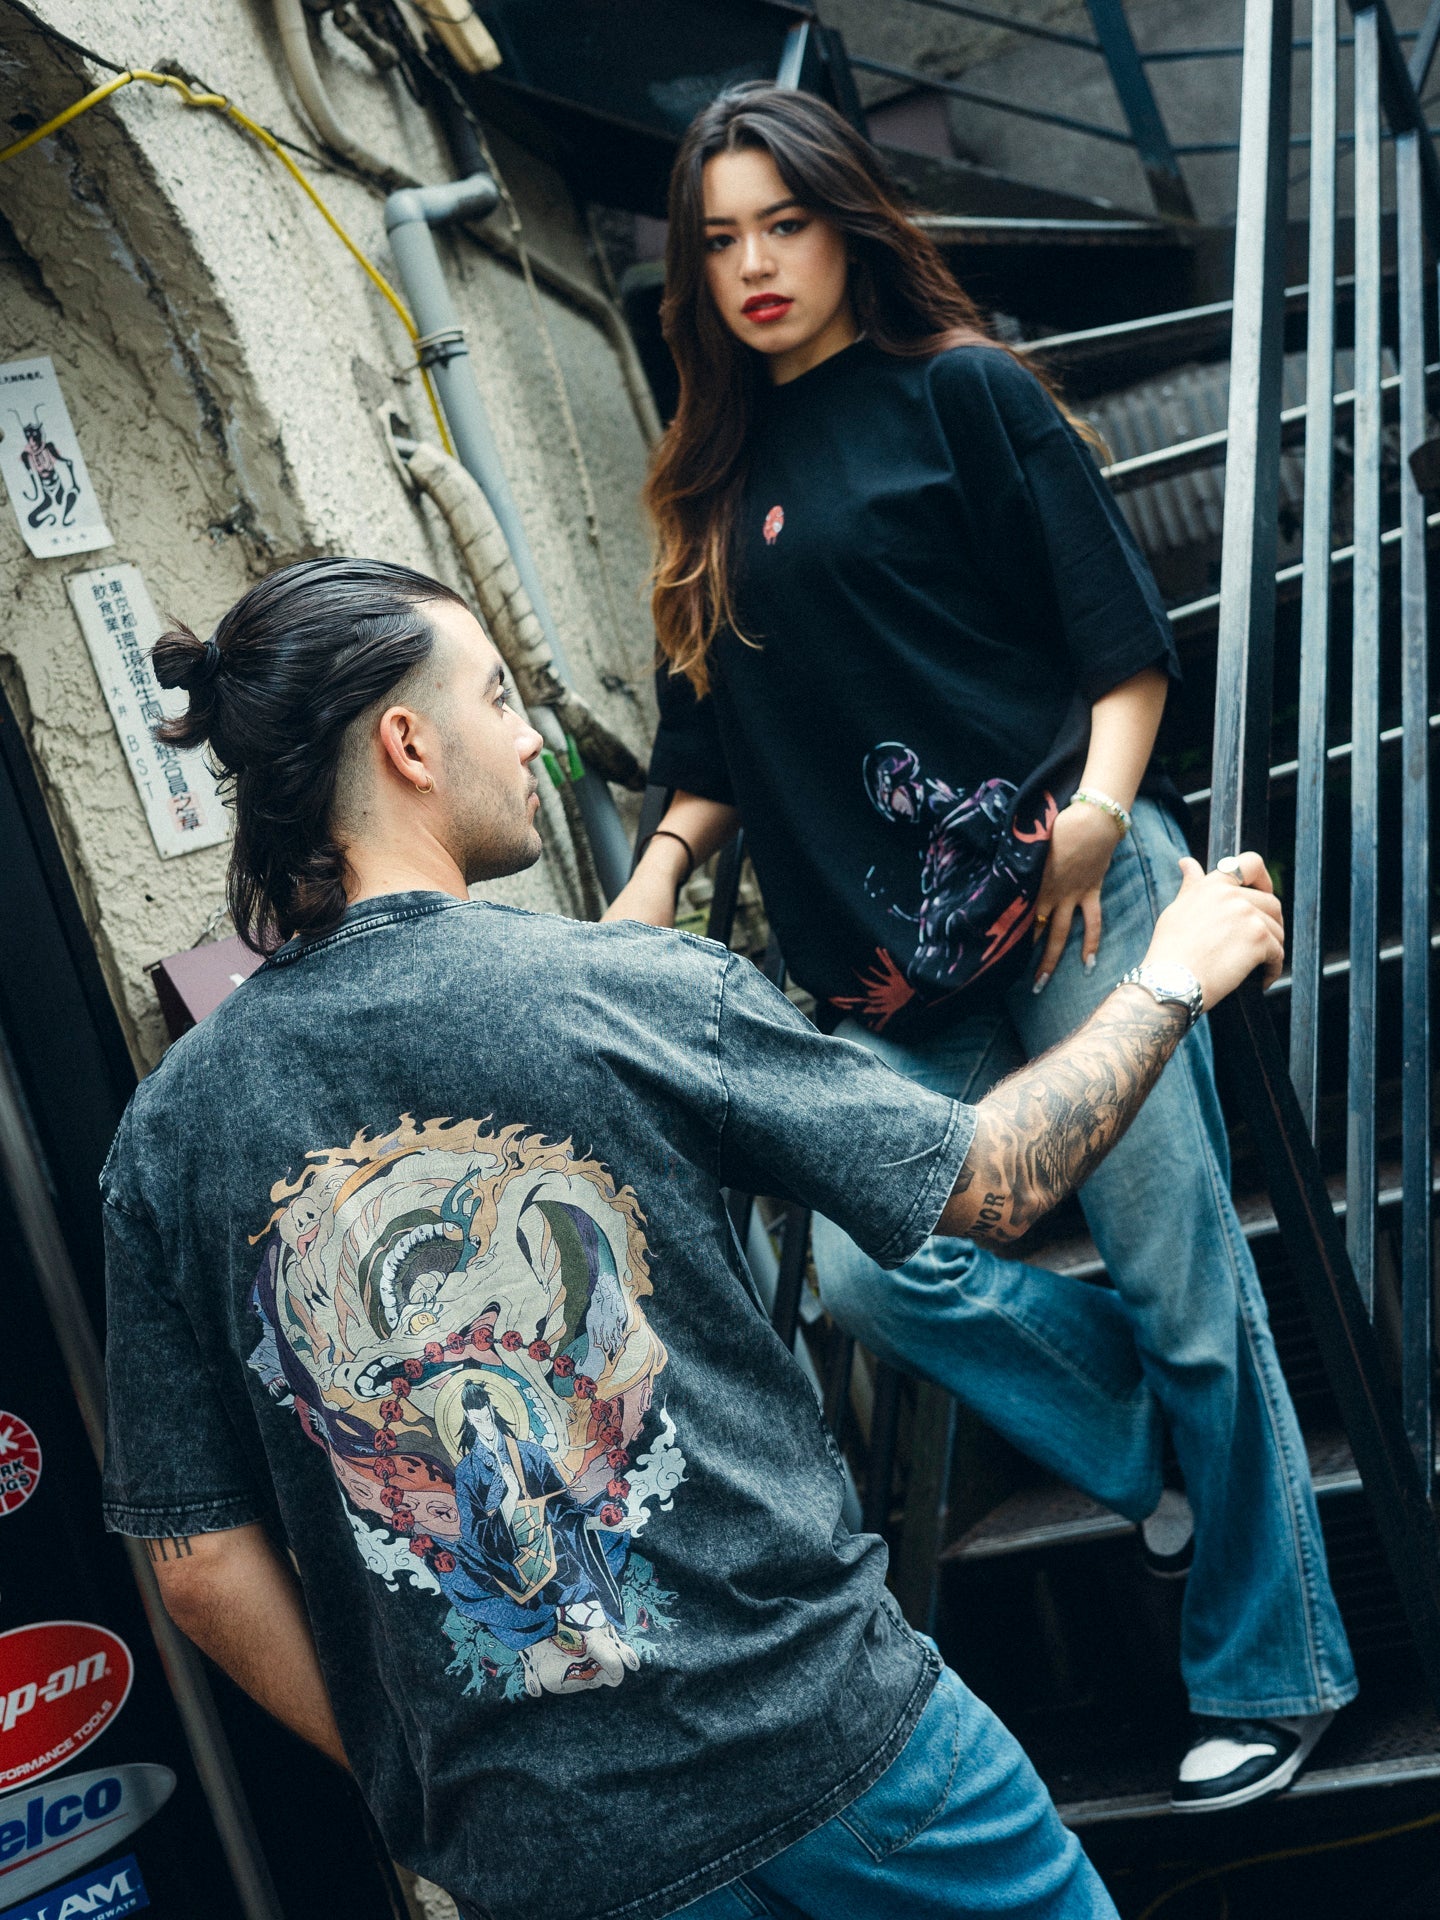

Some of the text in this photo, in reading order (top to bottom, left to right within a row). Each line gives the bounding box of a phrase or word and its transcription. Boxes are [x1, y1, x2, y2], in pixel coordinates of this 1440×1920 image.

[91, 584, 120, 634] 飲食業
[108, 580, 138, 630] 東京都
[113, 630, 202, 832] 環境衛生同組合員之章
[126, 734, 154, 799] BST
[74, 1700, 113, 1740] TOOLS
